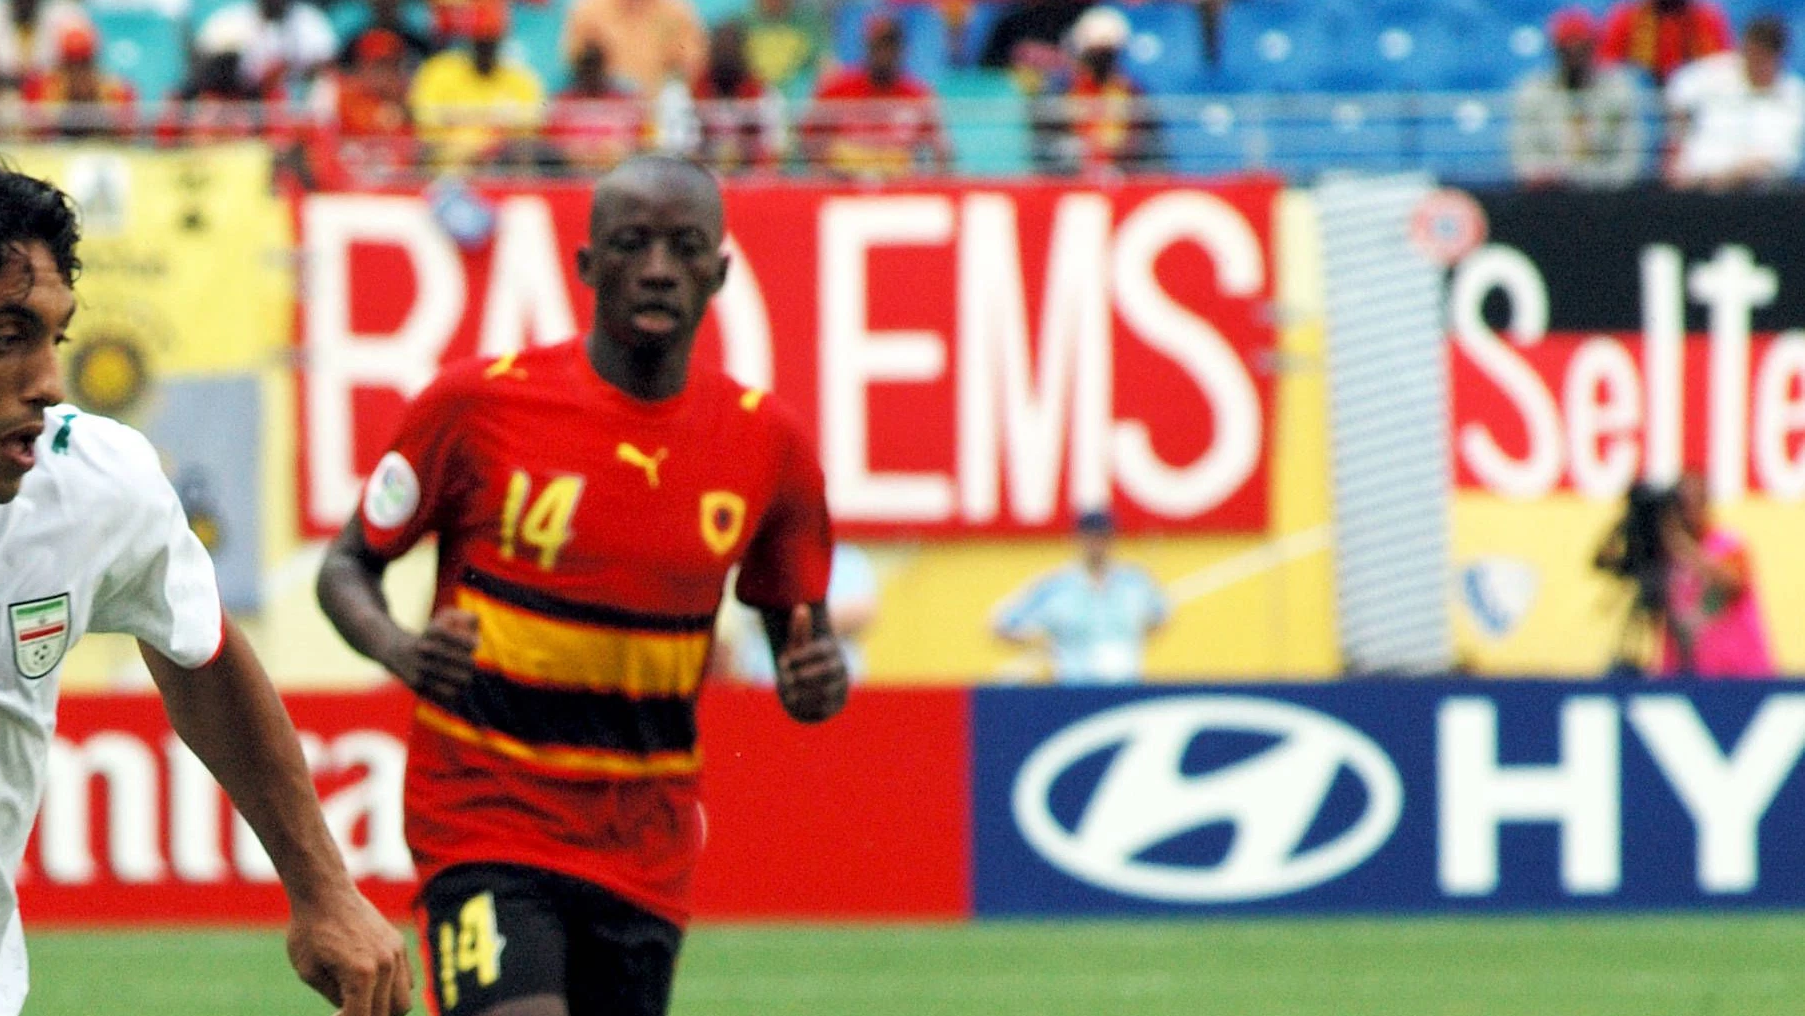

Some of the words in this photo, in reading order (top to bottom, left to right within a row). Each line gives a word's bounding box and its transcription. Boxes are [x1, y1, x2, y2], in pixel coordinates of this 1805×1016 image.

[817, 189, 1265, 522] EMS
[1451, 243, 1805, 503] Selte
[500, 469, 585, 571] 14
[1437, 695, 1805, 898] HY
[438, 891, 507, 1009] 14
